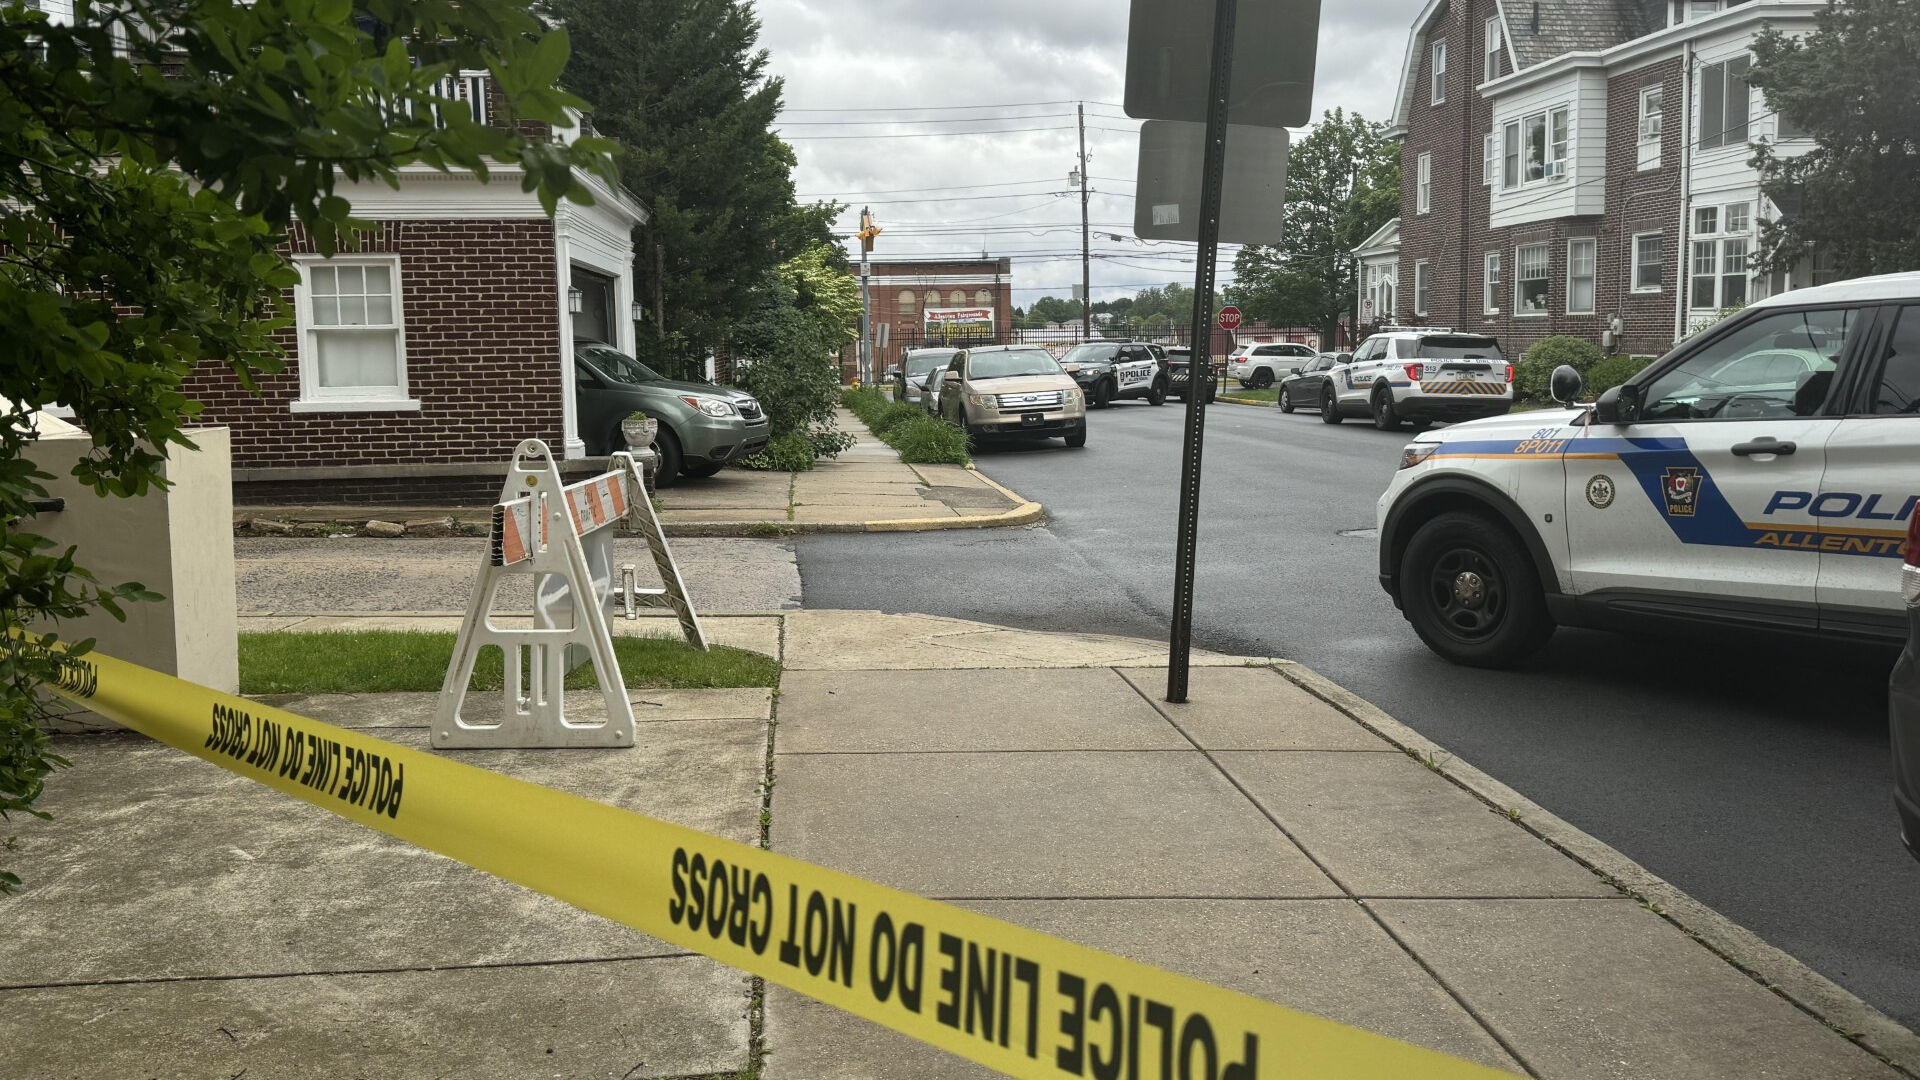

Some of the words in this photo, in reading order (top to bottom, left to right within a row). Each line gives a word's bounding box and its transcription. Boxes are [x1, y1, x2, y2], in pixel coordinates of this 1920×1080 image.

[1219, 313, 1240, 323] STOP
[1126, 370, 1151, 378] POLICE
[1531, 428, 1562, 439] 801
[1669, 504, 1693, 514] POLICE
[1755, 532, 1908, 555] ALLENT
[204, 702, 252, 760] CROSS
[246, 717, 281, 772] NOT
[279, 727, 305, 780] DO
[301, 734, 341, 795] LINE
[338, 745, 404, 819] POLICE
[669, 847, 773, 956] CROSS
[779, 883, 857, 988] NOT
[869, 911, 926, 1015] DO
[937, 932, 1040, 1060] LINE
